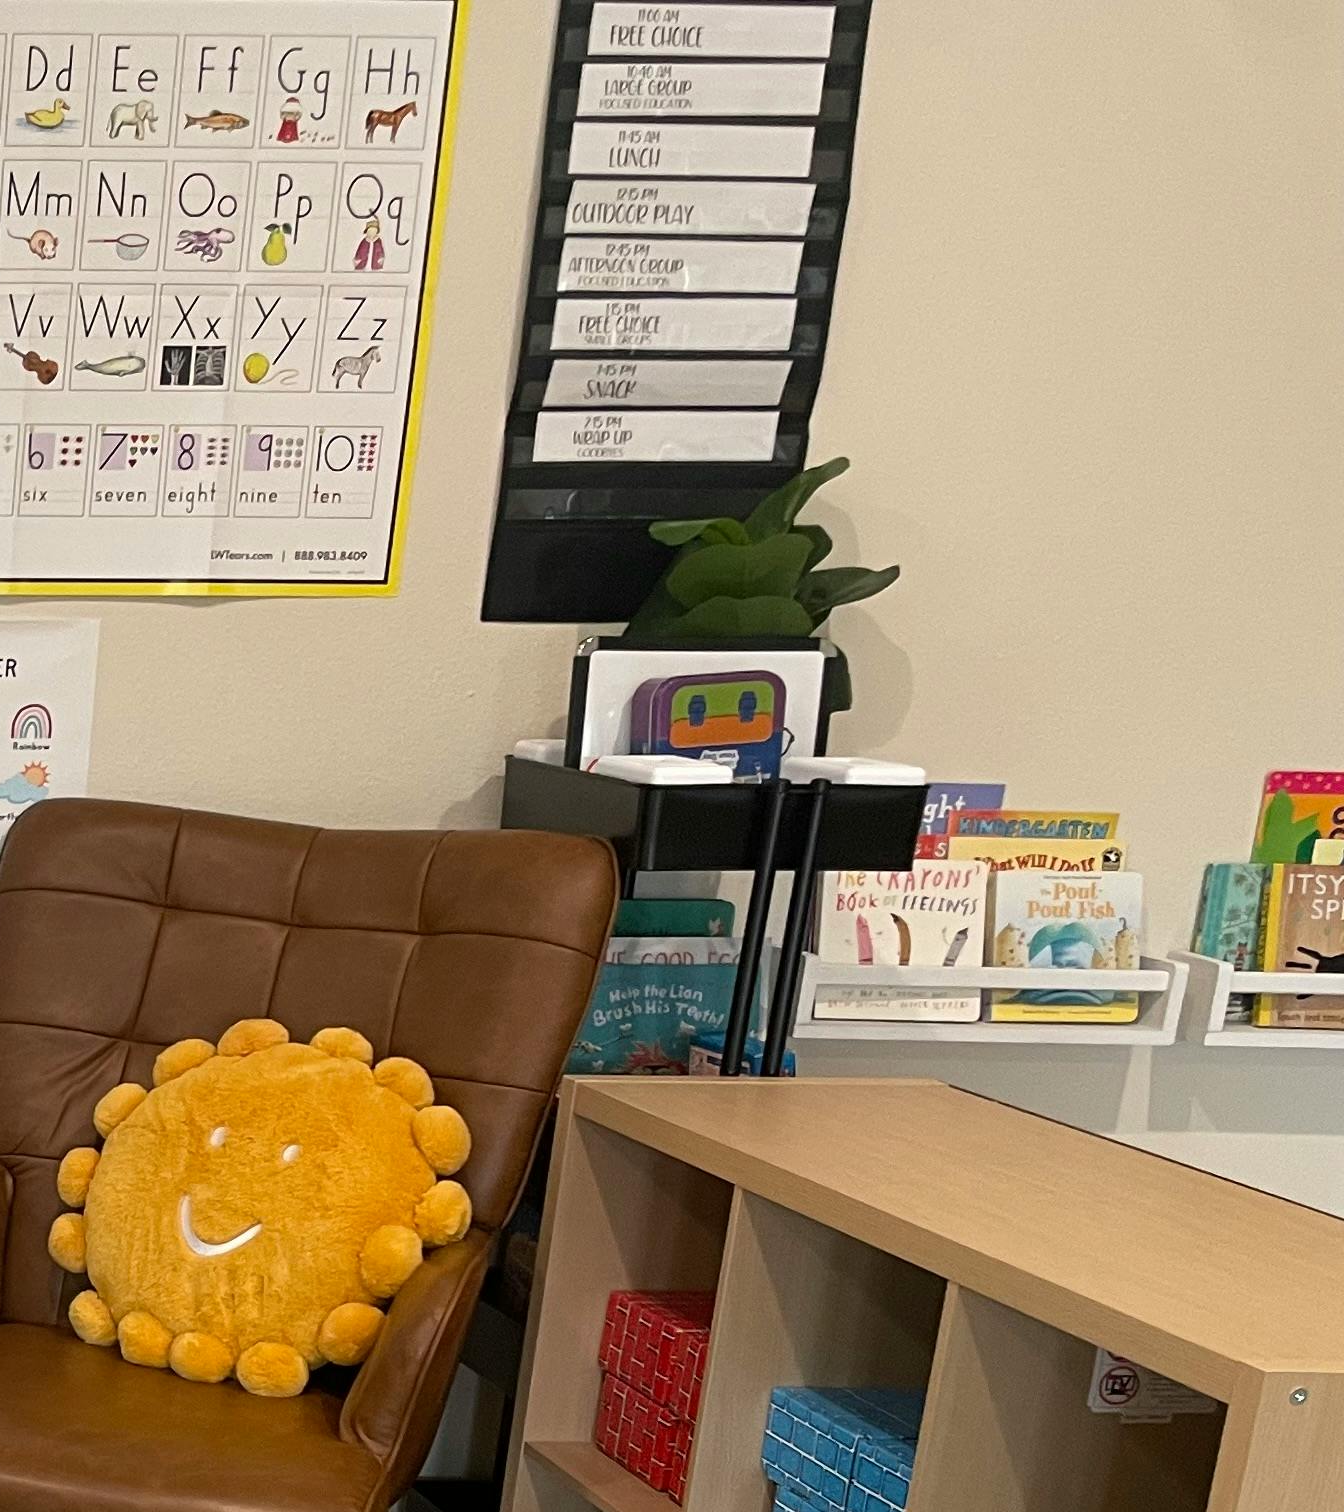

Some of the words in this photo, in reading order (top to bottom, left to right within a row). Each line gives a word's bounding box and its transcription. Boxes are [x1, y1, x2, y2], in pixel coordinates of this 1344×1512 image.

[610, 25, 646, 47] FREE
[651, 26, 705, 48] CHOICE
[26, 44, 74, 91] Dd
[112, 45, 158, 92] Ee
[198, 46, 244, 93] Ff
[278, 47, 330, 120] Gg
[365, 48, 420, 95] Hh
[604, 80, 643, 96] LARGE
[648, 80, 692, 96] GROUP
[608, 147, 661, 168] LUNCH
[6, 171, 72, 217] Mm
[97, 171, 146, 217] Nn
[178, 172, 238, 218] Oo
[274, 173, 312, 245] Pp
[346, 173, 410, 246] Qq
[572, 202, 648, 224] OUTDOOR
[653, 204, 695, 225] PLAY
[568, 257, 635, 273] AFTERNOON
[639, 258, 684, 274] GROUP
[9, 293, 54, 338] Vv
[79, 294, 151, 338] Ww
[171, 294, 221, 340] Xx
[250, 295, 307, 366] Yy
[336, 296, 389, 341] Zz
[578, 315, 611, 334] FREE
[615, 316, 660, 334] CHOICE
[583, 379, 637, 399] SNACK
[573, 430, 610, 445] WRAP
[613, 430, 633, 445] UP
[29, 432, 44, 470] 6
[98, 433, 129, 470] 7
[178, 434, 195, 470] 8
[258, 434, 273, 471] 9
[316, 434, 355, 472] 10
[23, 489, 48, 502] six
[95, 489, 147, 502] seven
[168, 482, 217, 514] eight
[239, 489, 278, 503] nine
[313, 484, 342, 504] ten
[12, 742, 50, 751] Rainbow
[960, 819, 1109, 838] KINDERGARTEN
[1288, 873, 1344, 895] ITSY
[1027, 901, 1073, 919] Pout
[1078, 901, 1115, 919] Fish
[593, 1001, 642, 1027] Brush
[645, 1001, 670, 1015] His
